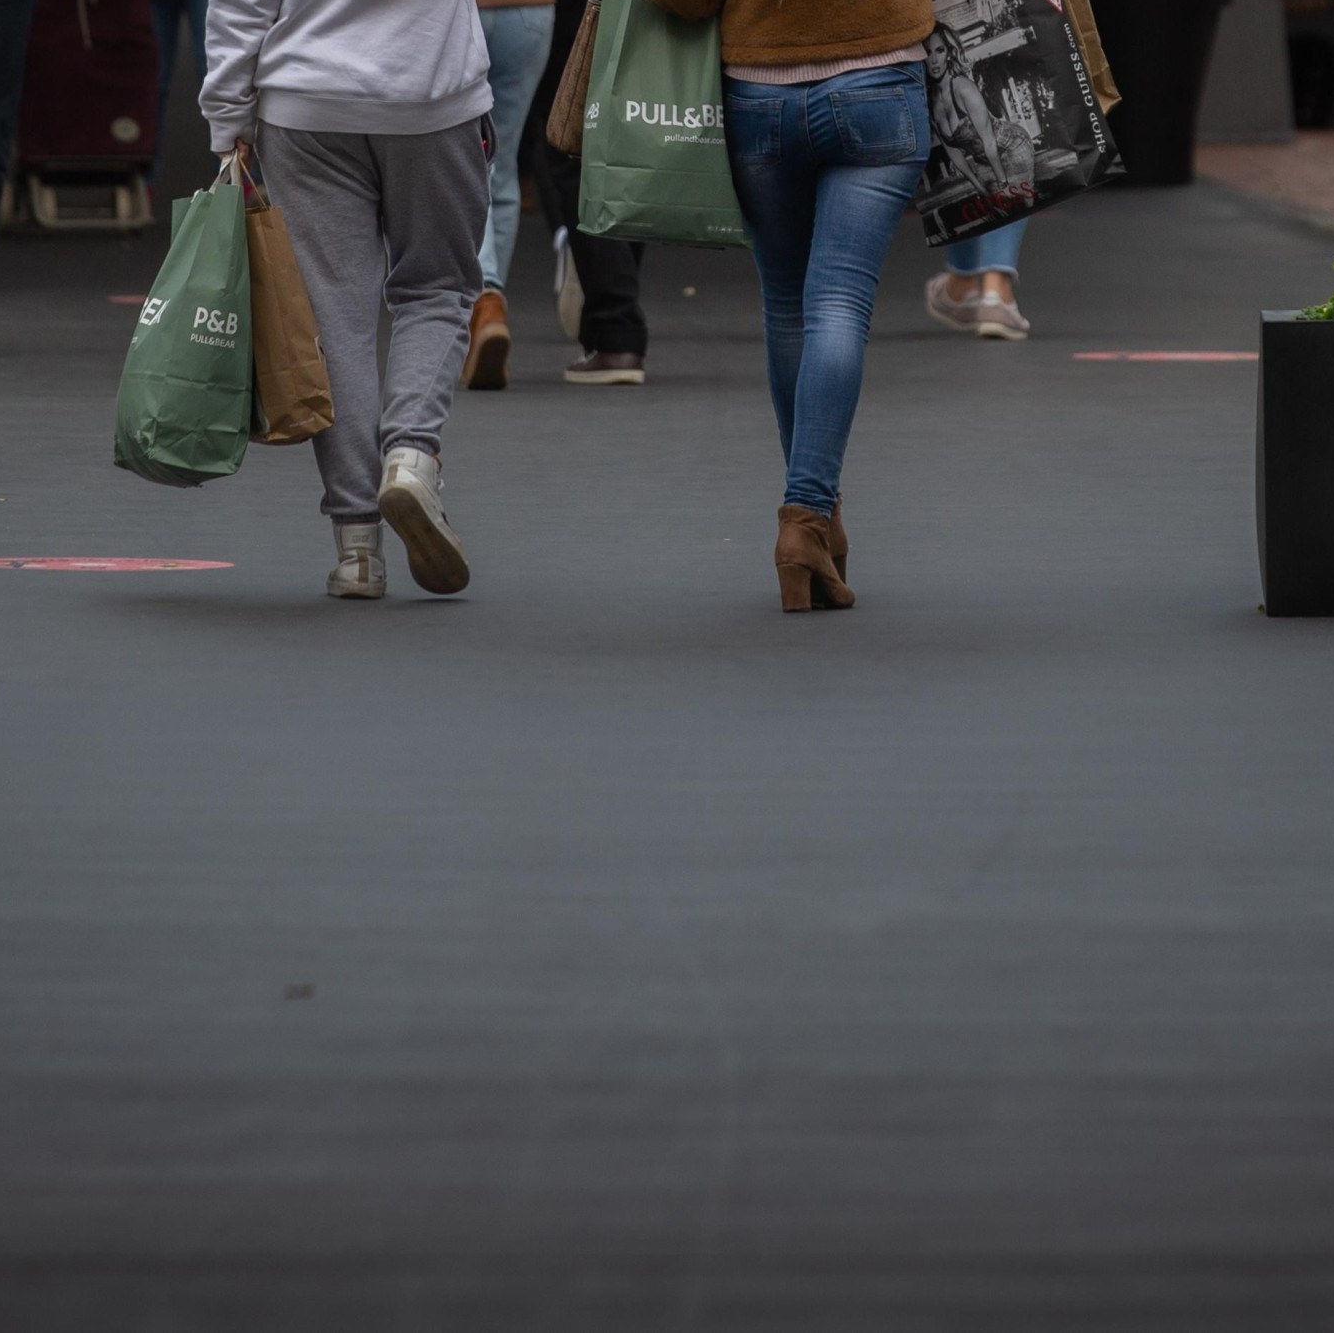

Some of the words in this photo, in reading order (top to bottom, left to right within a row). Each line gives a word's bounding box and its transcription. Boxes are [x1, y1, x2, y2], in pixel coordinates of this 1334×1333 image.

[1089, 111, 1107, 154] SHOP
[193, 306, 238, 335] P&B
[189, 332, 236, 349] PULL&BEAR
